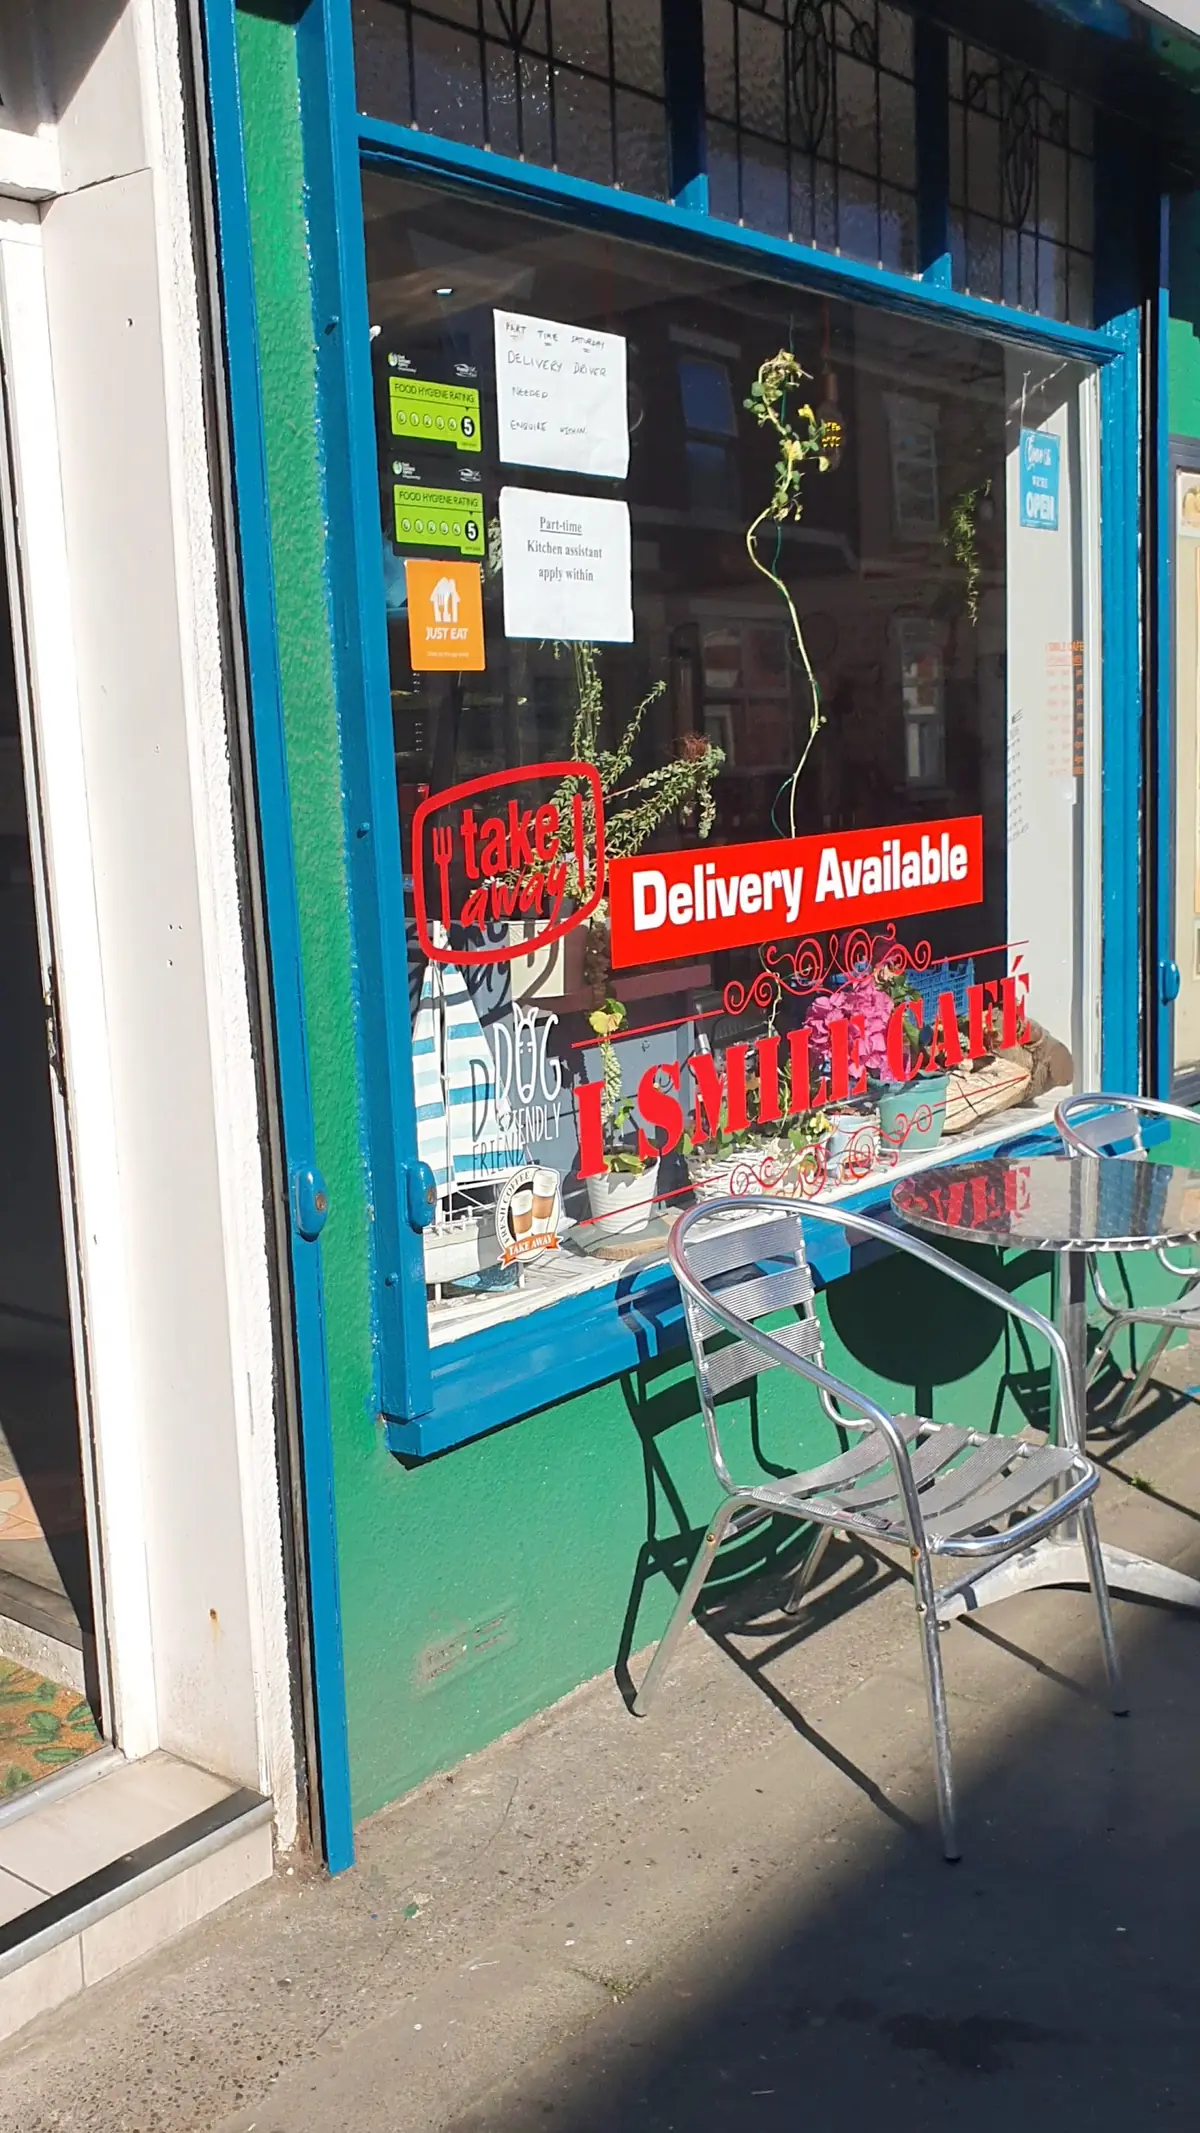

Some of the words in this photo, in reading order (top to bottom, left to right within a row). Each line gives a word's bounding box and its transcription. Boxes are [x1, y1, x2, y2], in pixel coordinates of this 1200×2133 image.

[505, 322, 527, 334] PART
[537, 330, 558, 342] TIME
[507, 350, 563, 373] DELIVERY
[572, 362, 607, 377] DRIVER
[395, 383, 417, 395] FOOD
[418, 387, 449, 400] HYGIENE
[449, 391, 475, 404] RATING
[512, 386, 549, 399] NEEDED
[463, 417, 473, 436] 5
[510, 419, 548, 432] ENQUIRE
[399, 490, 421, 502] FOOD
[422, 493, 453, 505] HYGIENE
[453, 496, 479, 508] RATING
[1026, 491, 1054, 520] OPEN
[467, 521, 477, 540] 5
[539, 516, 583, 534] Part-time
[527, 539, 563, 556] Kitchen
[564, 544, 603, 559] assistant
[538, 566, 562, 582] apply
[565, 567, 594, 581] within
[424, 626, 449, 641] JUST
[450, 627, 469, 641] EAT
[460, 799, 560, 879] take
[632, 862, 804, 932] Delivery
[814, 832, 968, 903] Available
[460, 863, 567, 937] away
[492, 1001, 562, 1107] DOG
[572, 1080, 609, 1180] I
[636, 1014, 868, 1162] SMILE
[886, 954, 1031, 1082] CAFÉ
[503, 1169, 531, 1205] COFFEE
[508, 1241, 530, 1257] TAKE
[530, 1233, 554, 1249] AWAY
